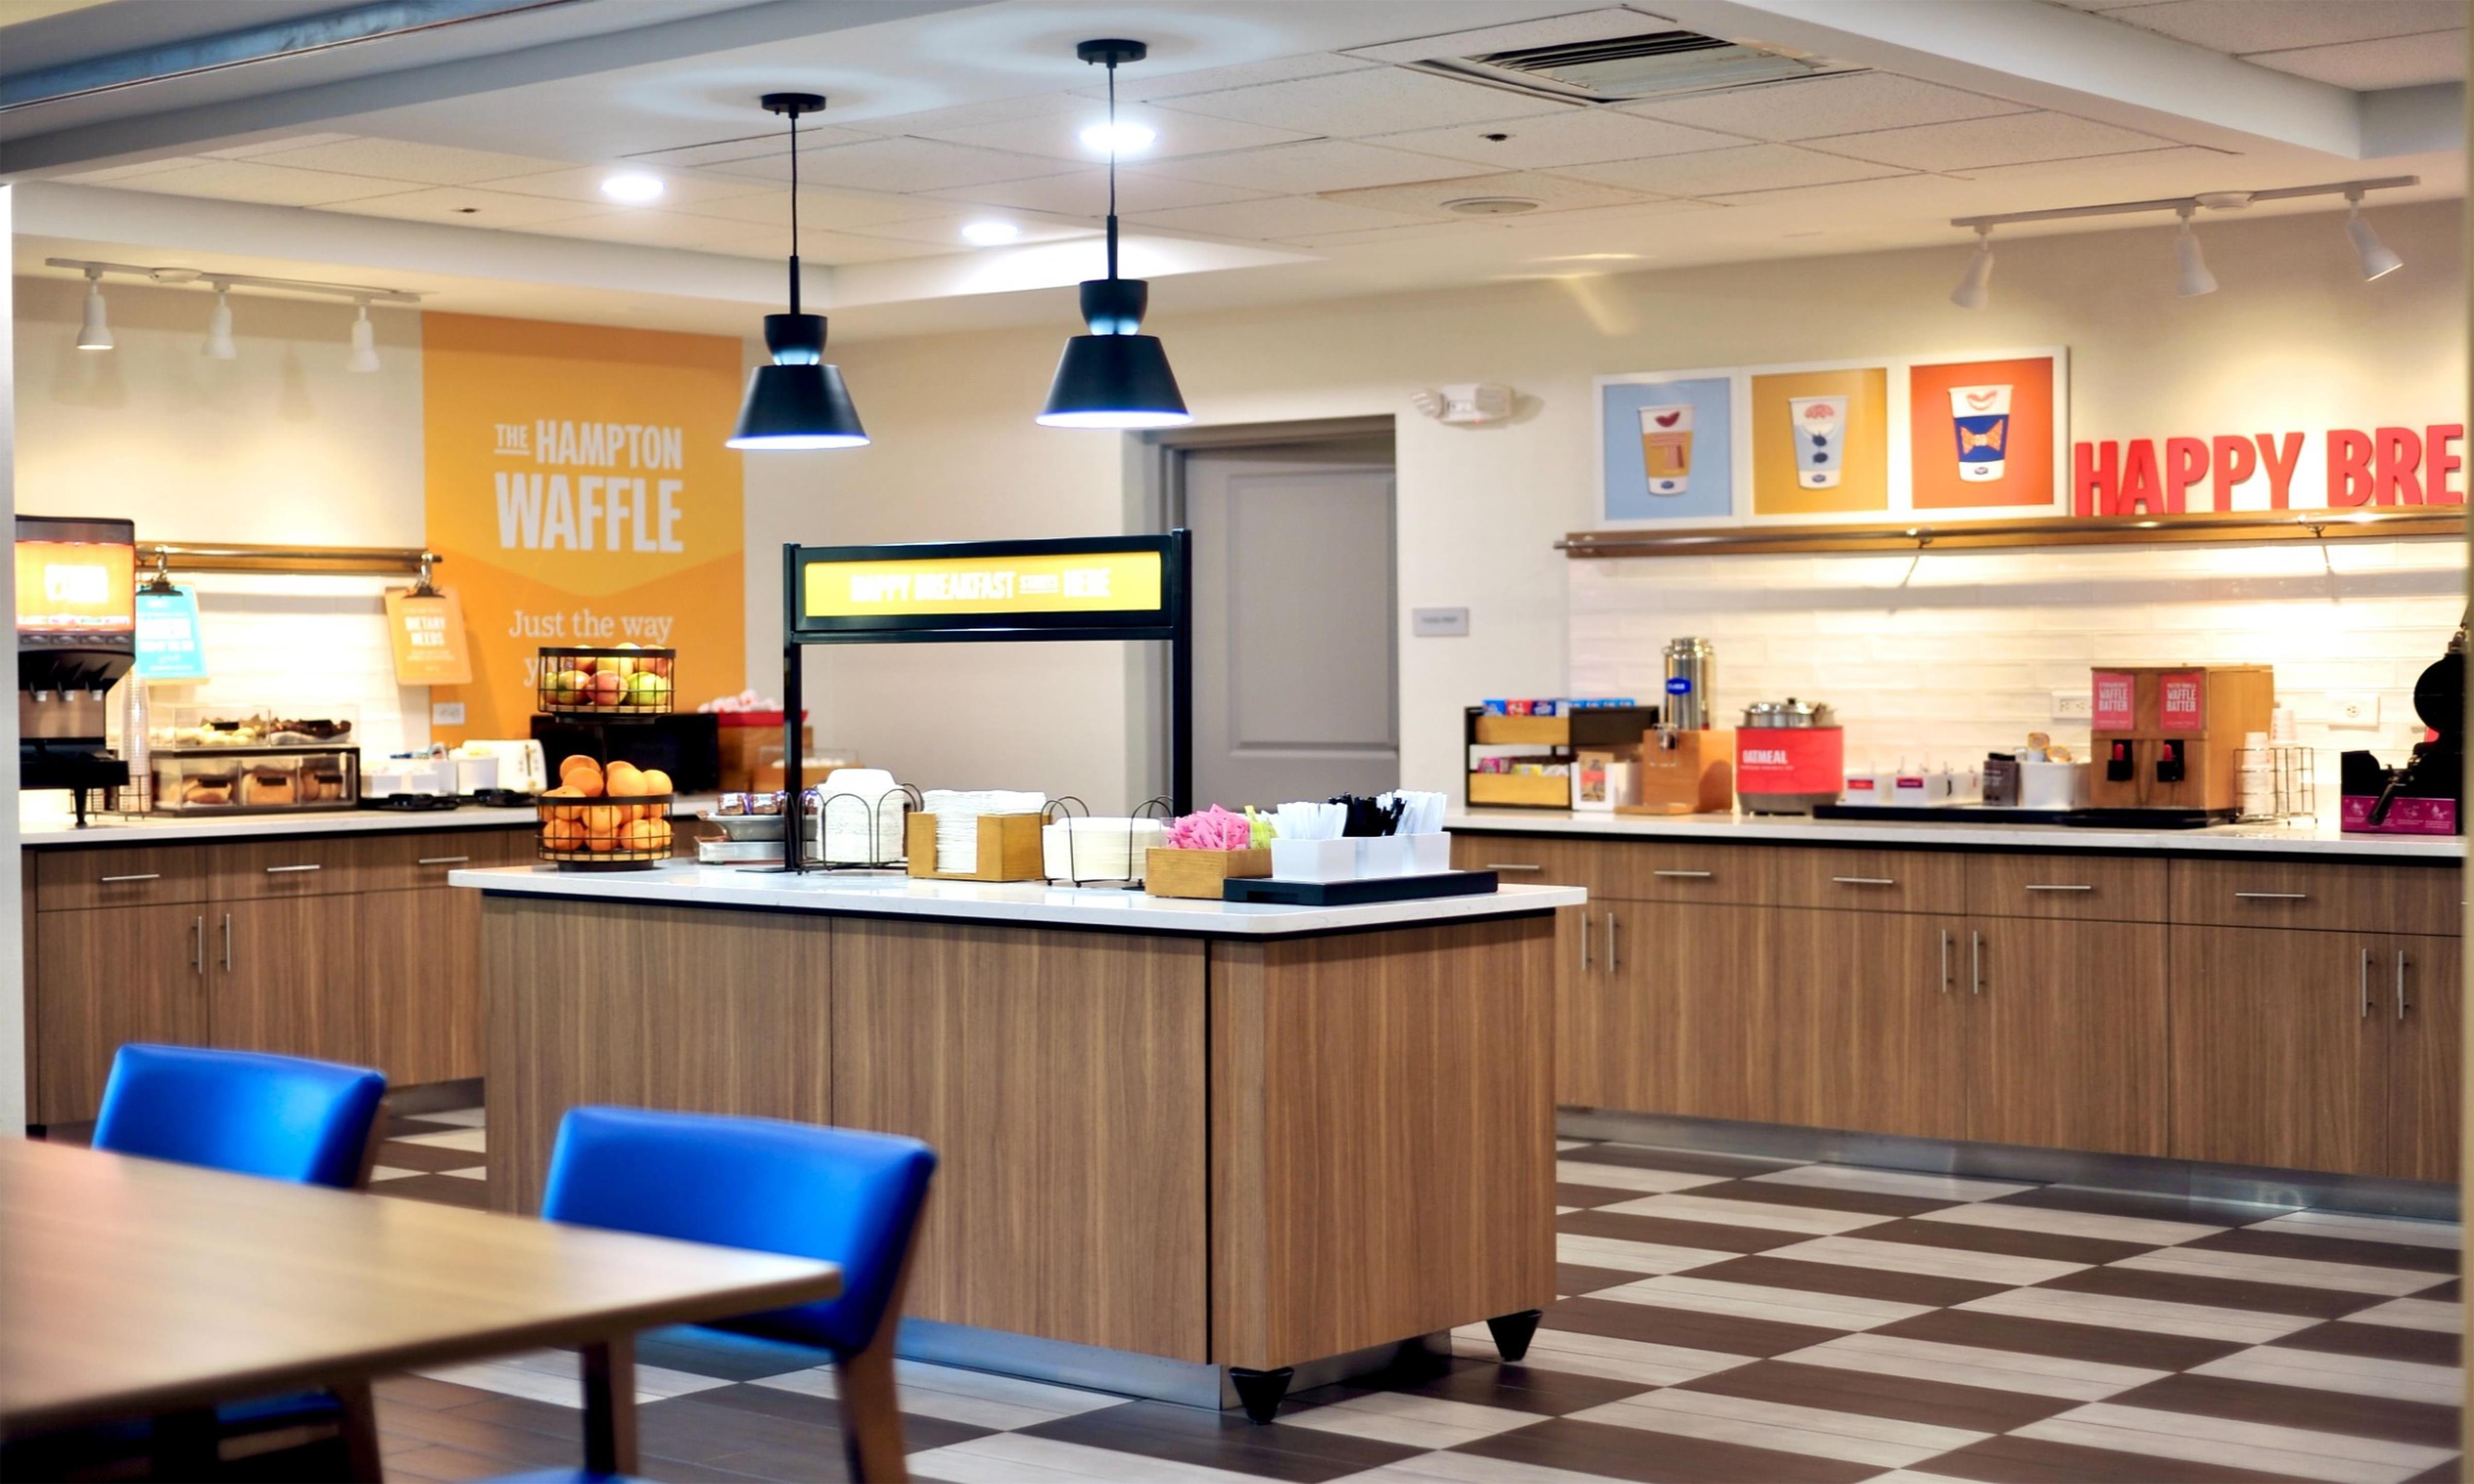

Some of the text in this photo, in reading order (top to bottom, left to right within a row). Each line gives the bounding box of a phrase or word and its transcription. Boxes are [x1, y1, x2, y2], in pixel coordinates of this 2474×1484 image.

[495, 419, 683, 470] THE HAMPTON
[2075, 424, 2464, 517] HAPPY BRE
[495, 472, 684, 553] WAFFLE
[850, 575, 910, 602] HAPPY
[914, 571, 1016, 601] BREAKFAST
[1063, 568, 1112, 597] HERE
[509, 608, 674, 644] Just the way
[2099, 688, 2128, 700] WAFFLE
[2099, 699, 2128, 711] BATTER
[2166, 700, 2196, 712] BATTER
[2167, 689, 2196, 700] WAFFLE
[1743, 749, 1788, 765] OATMEAL
